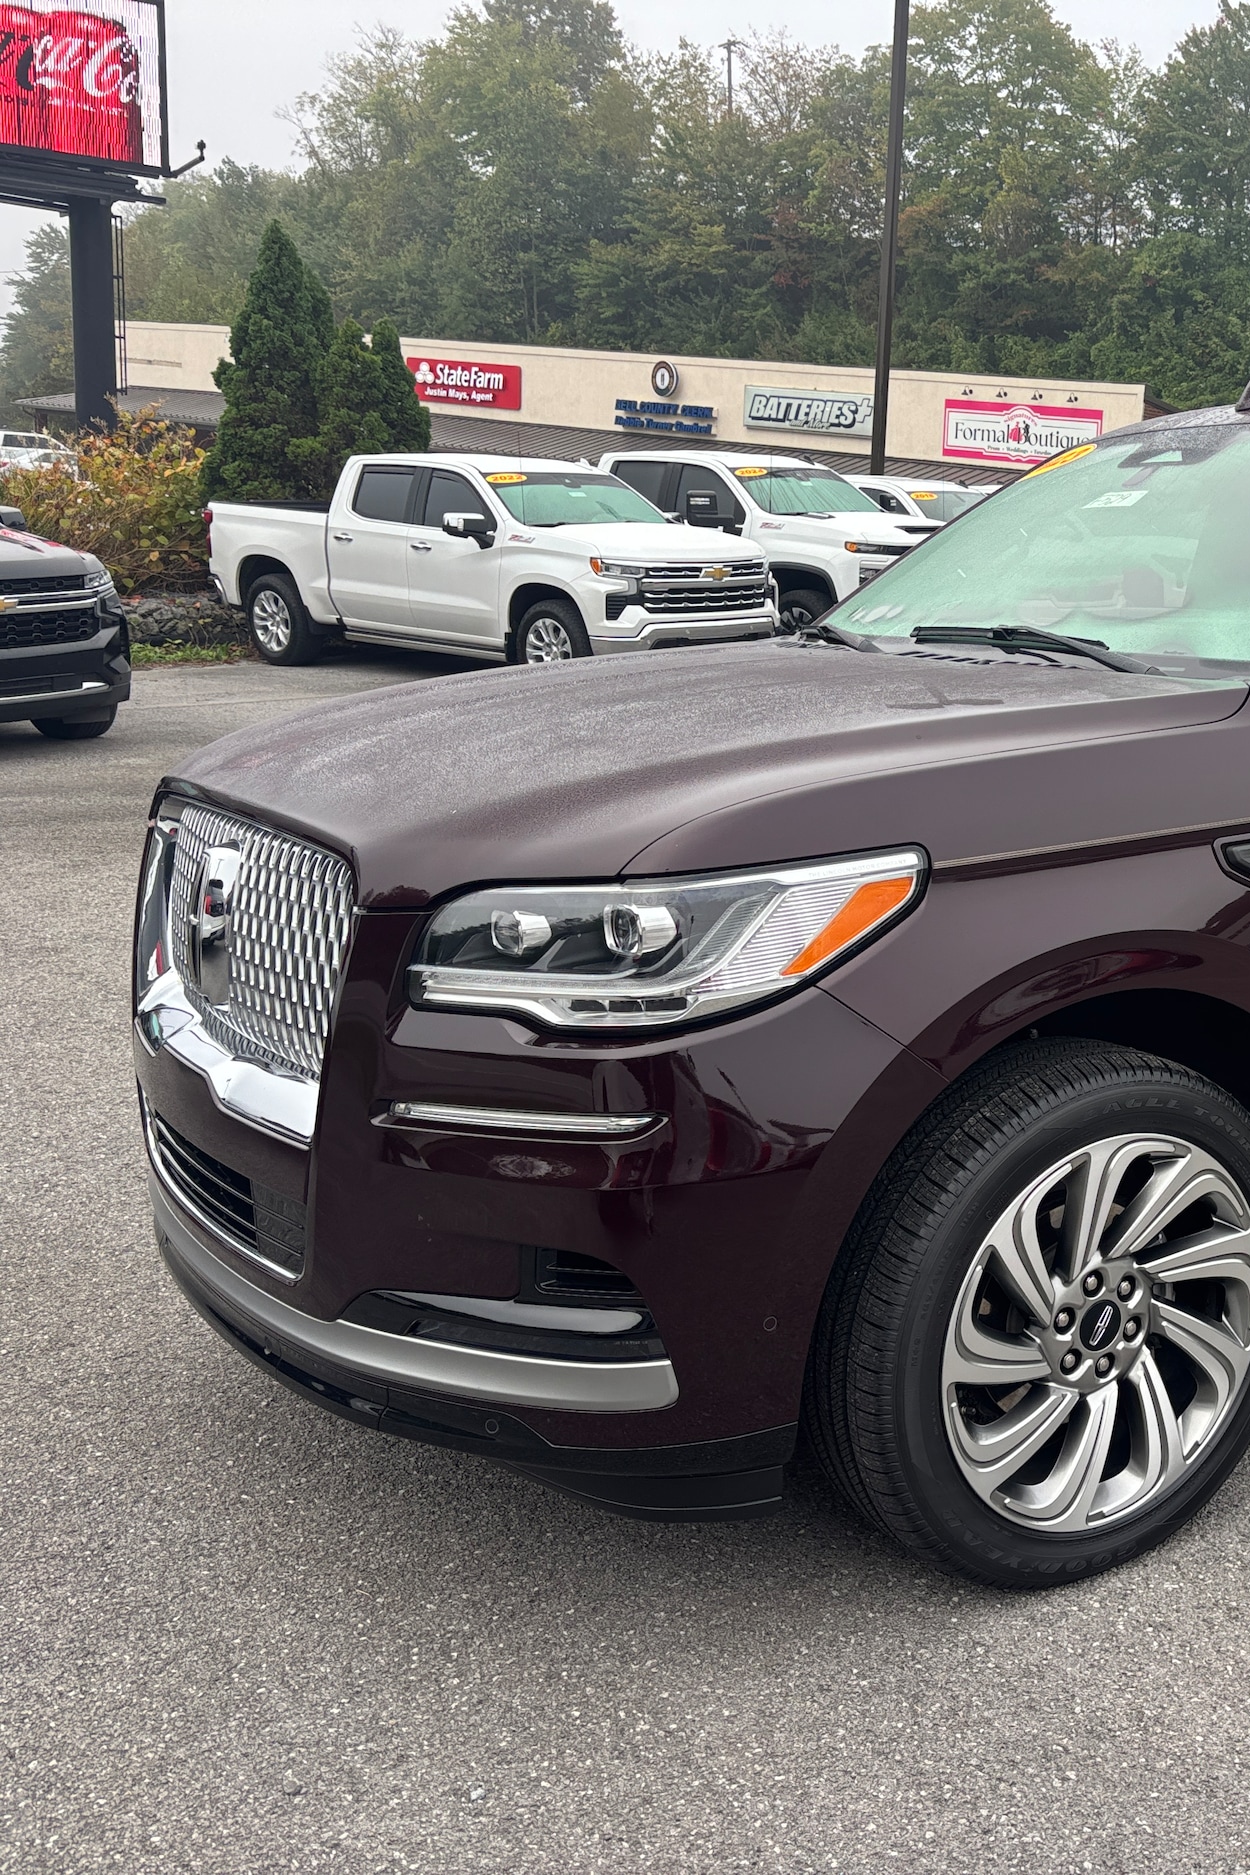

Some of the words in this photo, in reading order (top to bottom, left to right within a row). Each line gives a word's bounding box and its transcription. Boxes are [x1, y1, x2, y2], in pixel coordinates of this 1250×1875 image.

[424, 386, 447, 397] Justin
[448, 388, 469, 401] Mays,
[471, 390, 493, 402] Agent
[639, 401, 680, 415] COUNTY
[681, 405, 714, 418] CLERK
[954, 421, 1010, 444] Formal
[823, 867, 851, 876] LINCOLN
[852, 863, 875, 872] MOTOR
